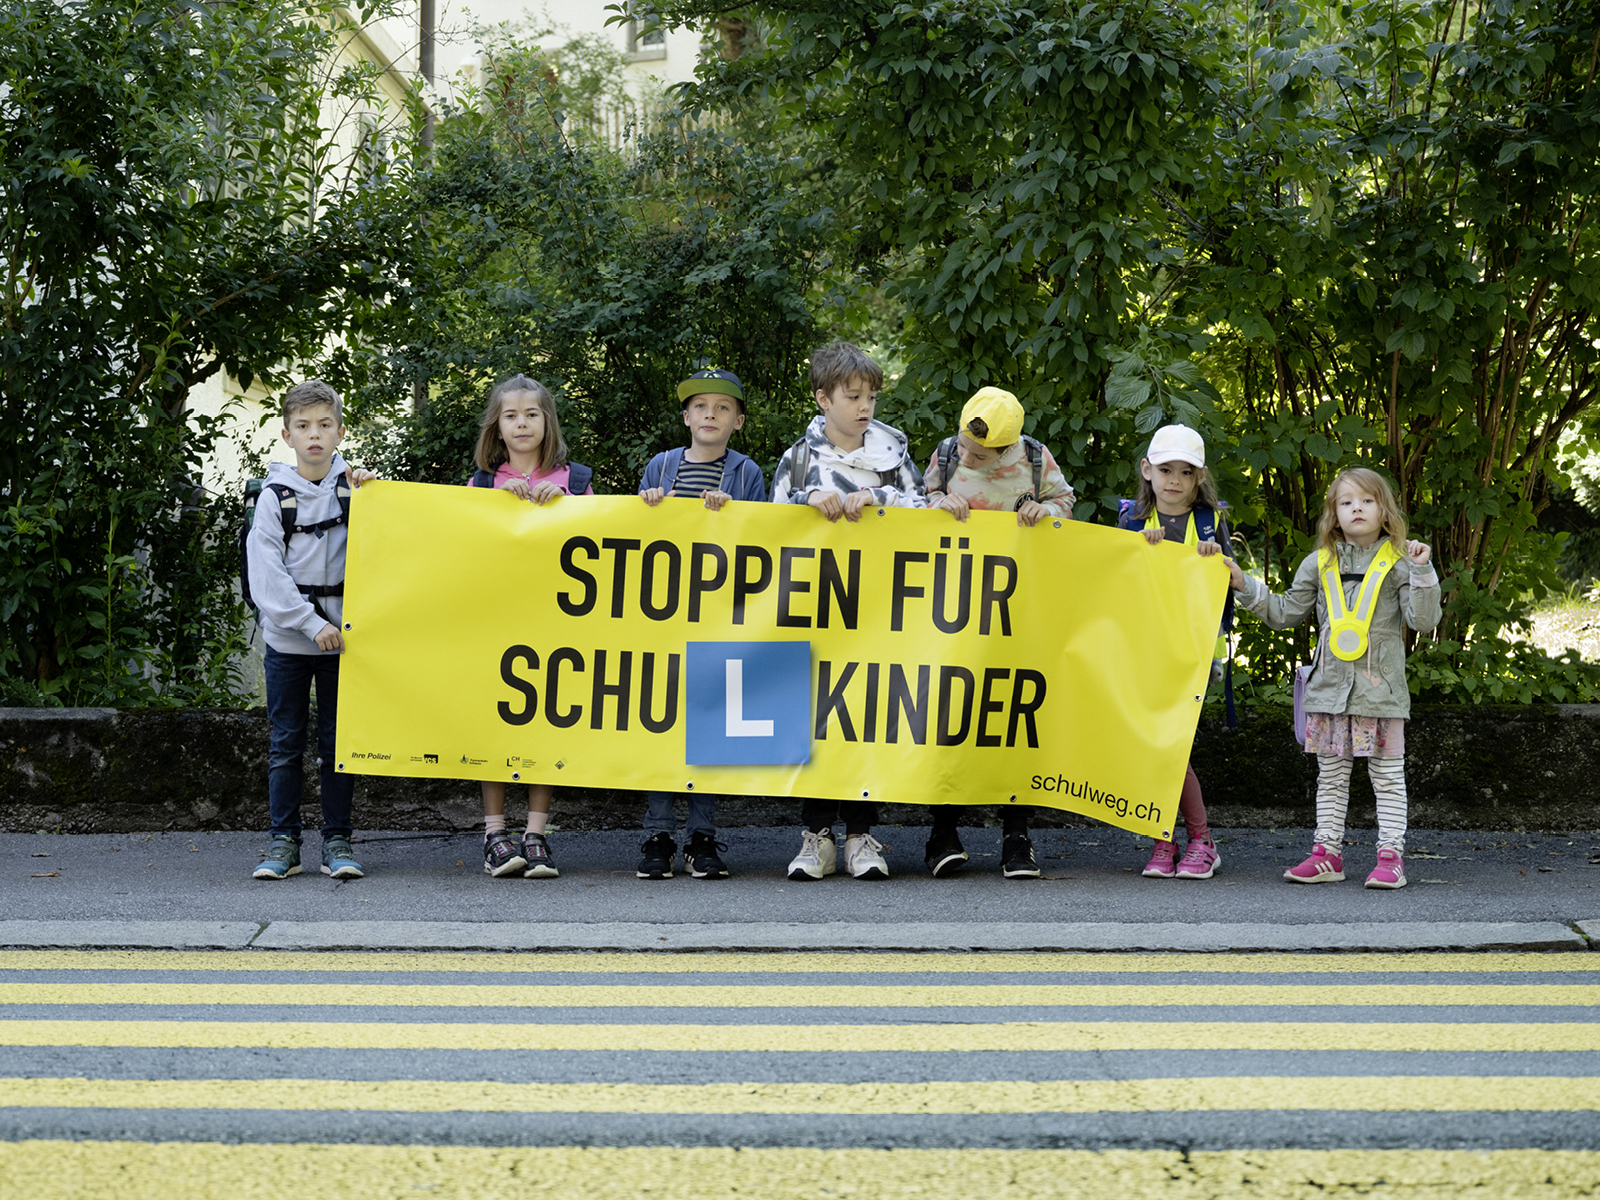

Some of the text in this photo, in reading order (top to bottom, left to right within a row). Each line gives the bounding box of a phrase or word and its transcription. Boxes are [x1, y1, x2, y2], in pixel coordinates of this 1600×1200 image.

[556, 535, 1018, 637] STOPPEN FÜR
[367, 752, 392, 761] Polizei
[1030, 773, 1161, 823] schulweg.ch
